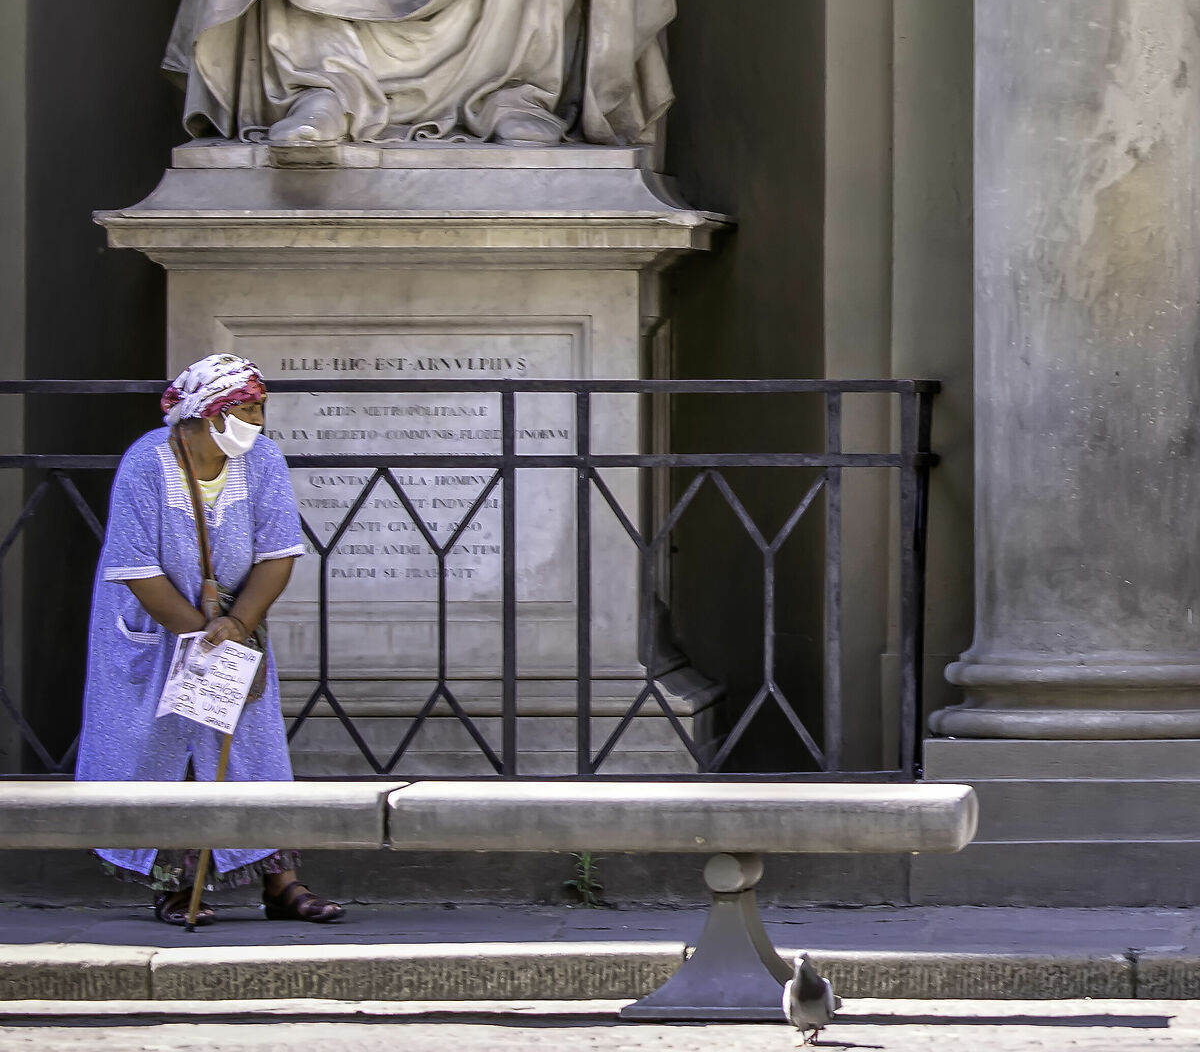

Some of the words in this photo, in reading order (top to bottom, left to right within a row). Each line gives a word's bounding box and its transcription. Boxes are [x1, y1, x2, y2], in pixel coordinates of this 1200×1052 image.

[280, 358, 324, 371] ILLE
[332, 358, 367, 371] HIC
[374, 358, 408, 371] EST
